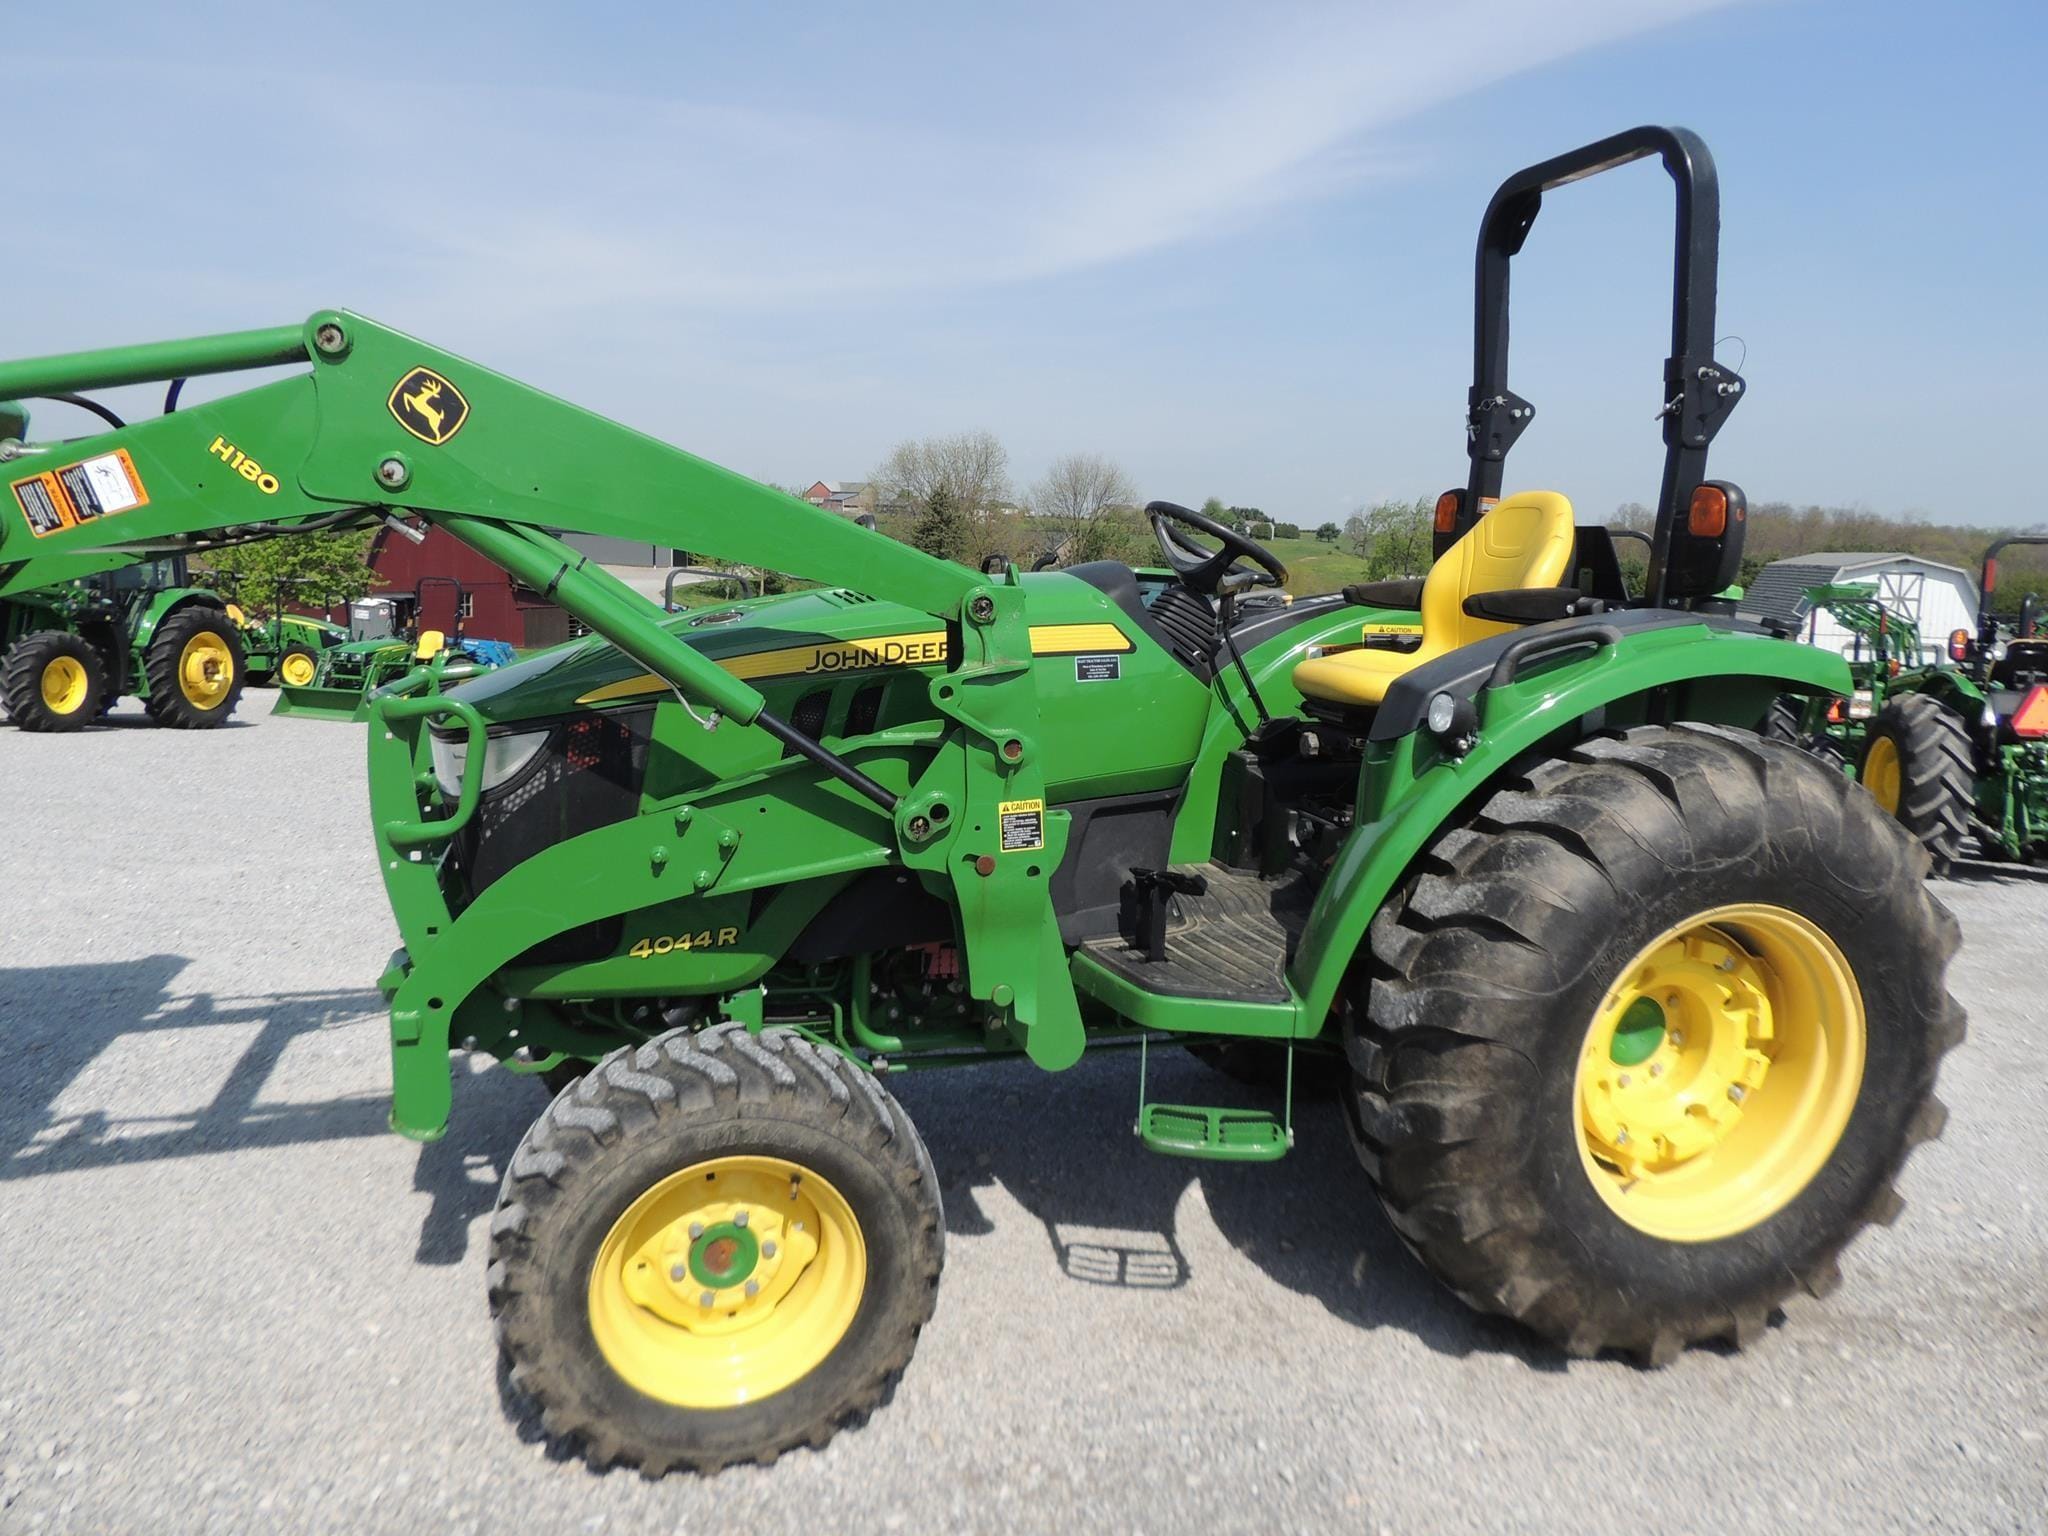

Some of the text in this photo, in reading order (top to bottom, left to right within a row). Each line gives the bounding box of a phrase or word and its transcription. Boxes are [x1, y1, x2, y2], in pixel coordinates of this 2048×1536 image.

[209, 436, 280, 494] H180
[805, 648, 879, 671] JOHN
[1010, 801, 1041, 811] CAUTION
